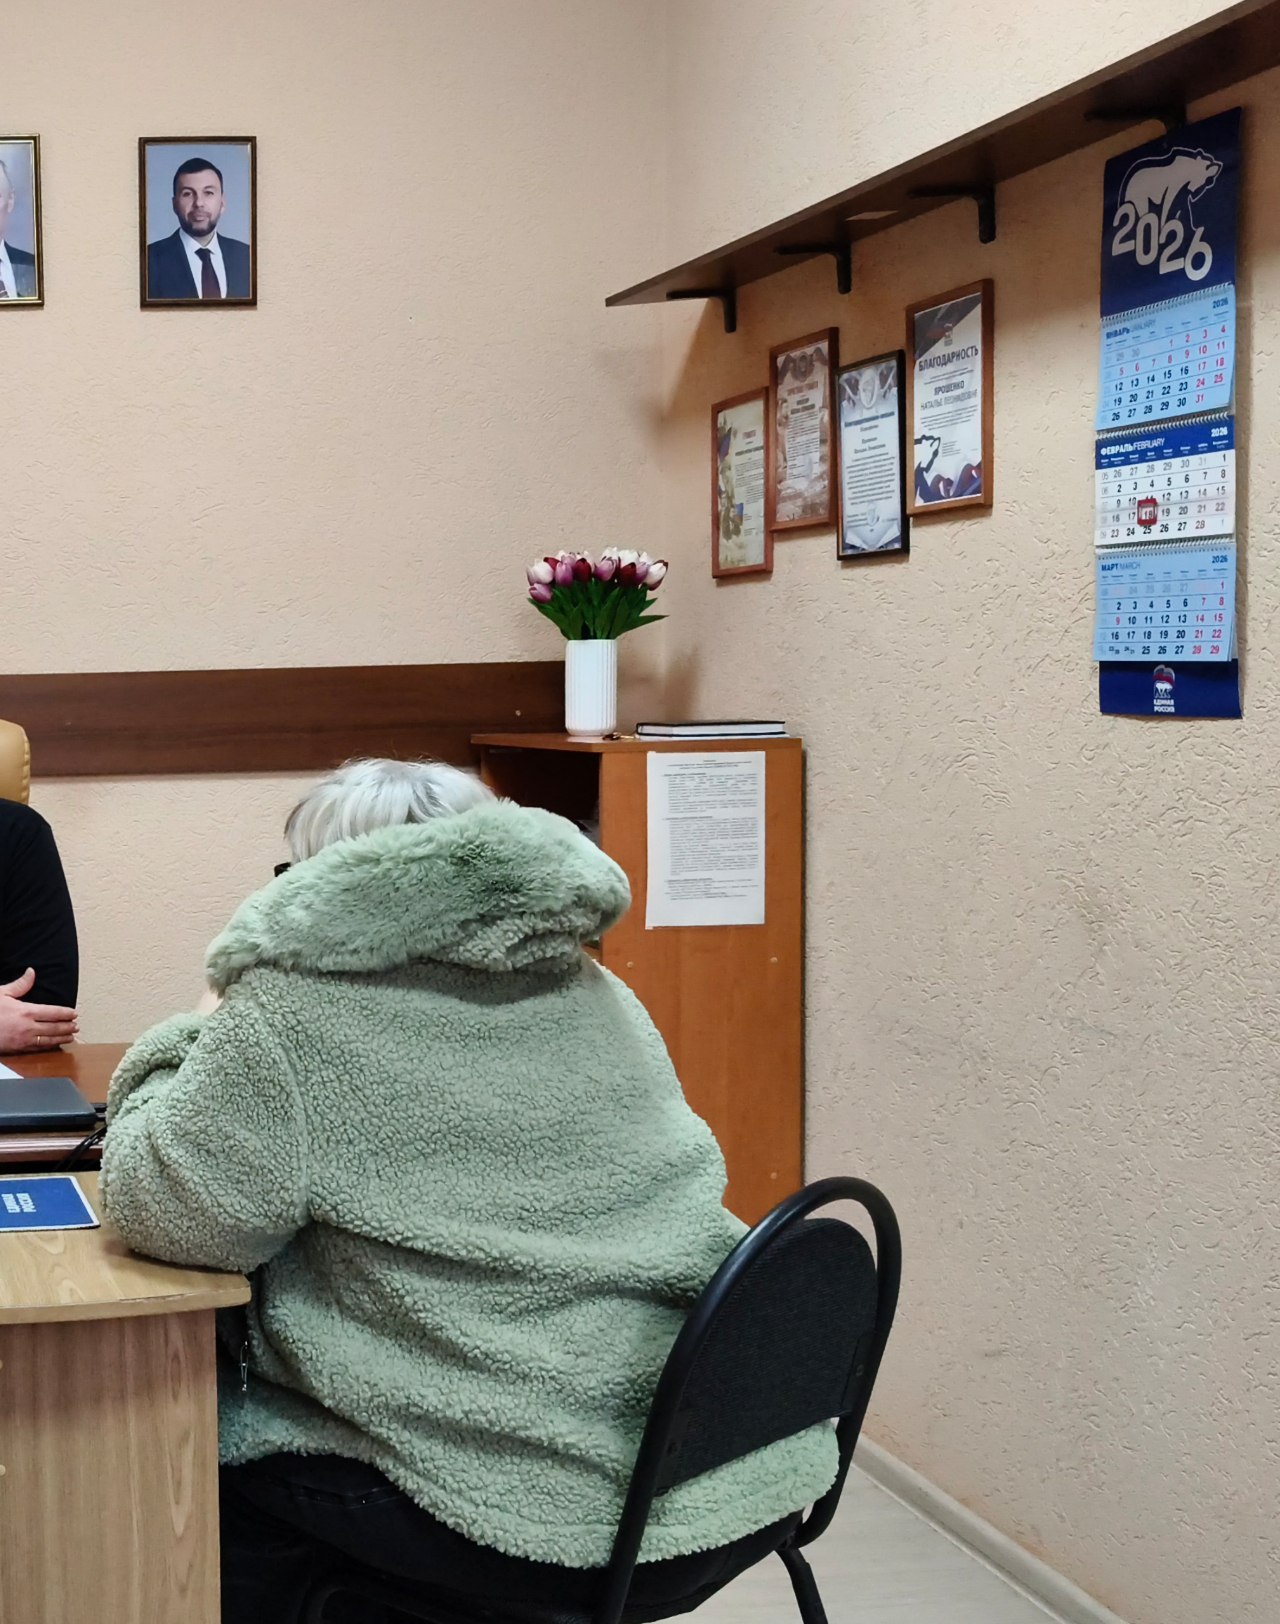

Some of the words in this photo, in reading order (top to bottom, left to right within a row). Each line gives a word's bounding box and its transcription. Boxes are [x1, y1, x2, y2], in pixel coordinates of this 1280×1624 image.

[1112, 202, 1213, 281] 2026
[1186, 334, 1190, 342] 2
[1203, 330, 1207, 338] 3
[919, 345, 978, 371] БЛАГОДАРНОСТЬ
[1120, 367, 1123, 376] 5
[1135, 363, 1139, 371] 6
[1185, 350, 1189, 358] 9
[1199, 345, 1207, 355] 10
[1217, 342, 1225, 350] 11
[1115, 382, 1123, 391] 12
[1131, 378, 1139, 387] 13
[1147, 375, 1155, 384] 14
[1164, 370, 1171, 379] 15
[1181, 366, 1189, 375] 16
[1198, 362, 1206, 371] 17
[1216, 357, 1224, 367] 18
[934, 381, 964, 395] ЯРОШЕНКО
[1114, 397, 1122, 406] 19
[1129, 394, 1137, 403] 20
[1146, 391, 1153, 399] 21
[1162, 386, 1170, 395] 22
[1179, 382, 1187, 391] 23
[1196, 378, 1205, 388] 24
[1214, 374, 1223, 383] 25
[1112, 412, 1120, 421] 26
[1128, 409, 1136, 418] 27
[1144, 405, 1152, 414] 28
[1160, 401, 1169, 411] 29
[1177, 397, 1186, 407] 30
[1196, 394, 1204, 403] 31
[1101, 444, 1134, 455] ФЕВРАЛЬ
[1133, 438, 1165, 450] FEBRUARY
[1211, 427, 1228, 437] 2026
[1114, 469, 1122, 478] 26
[1130, 467, 1138, 476] 27
[1147, 464, 1154, 473] 28
[1163, 462, 1172, 470] 29
[1181, 459, 1189, 468] 30
[1118, 484, 1122, 492] 2
[1133, 482, 1137, 490] 3
[1150, 480, 1154, 488] 4
[1168, 478, 1172, 486] 5
[1185, 474, 1189, 483] 6
[1204, 472, 1207, 480] 7
[1221, 469, 1225, 478] 8
[1117, 499, 1121, 508] 9
[1162, 493, 1171, 502] 12
[1180, 491, 1188, 500] 13
[1198, 488, 1206, 497] 14
[1217, 486, 1225, 495] 15
[1112, 514, 1119, 523] 16
[1128, 512, 1135, 520] 17
[1162, 508, 1170, 517] 19
[1179, 506, 1188, 515] 20
[1198, 505, 1206, 513] 21
[1216, 502, 1225, 511] 22
[1111, 529, 1119, 538] 23
[1127, 528, 1135, 536] 24
[1143, 526, 1152, 534] 25
[1160, 524, 1168, 532] 26
[1178, 522, 1186, 531] 27
[1196, 520, 1205, 529] 28
[1102, 563, 1118, 571] МАРТ
[1212, 555, 1228, 563] 2026
[1117, 602, 1121, 610] 2
[1133, 601, 1137, 609] 3
[1166, 600, 1170, 608] 5
[1183, 598, 1188, 607] 6
[1202, 597, 1206, 605] 7
[1219, 597, 1224, 605] 8
[1116, 617, 1120, 625] 9
[1128, 616, 1136, 624] 10
[1145, 616, 1152, 624] 11
[1161, 615, 1169, 623] 12
[1178, 614, 1186, 623] 13
[1196, 614, 1204, 622] 14
[1214, 614, 1223, 622] 15
[1112, 632, 1119, 640] 16
[1127, 631, 1135, 639] 17
[1144, 631, 1151, 639] 18
[1160, 630, 1168, 638] 19
[1176, 630, 1185, 638] 20
[1195, 630, 1203, 638] 21
[1212, 629, 1221, 638] 22
[1142, 646, 1150, 654] 25
[1158, 646, 1166, 654] 26
[1175, 646, 1184, 654] 27
[1192, 646, 1201, 654] 28
[1210, 645, 1219, 654] 29
